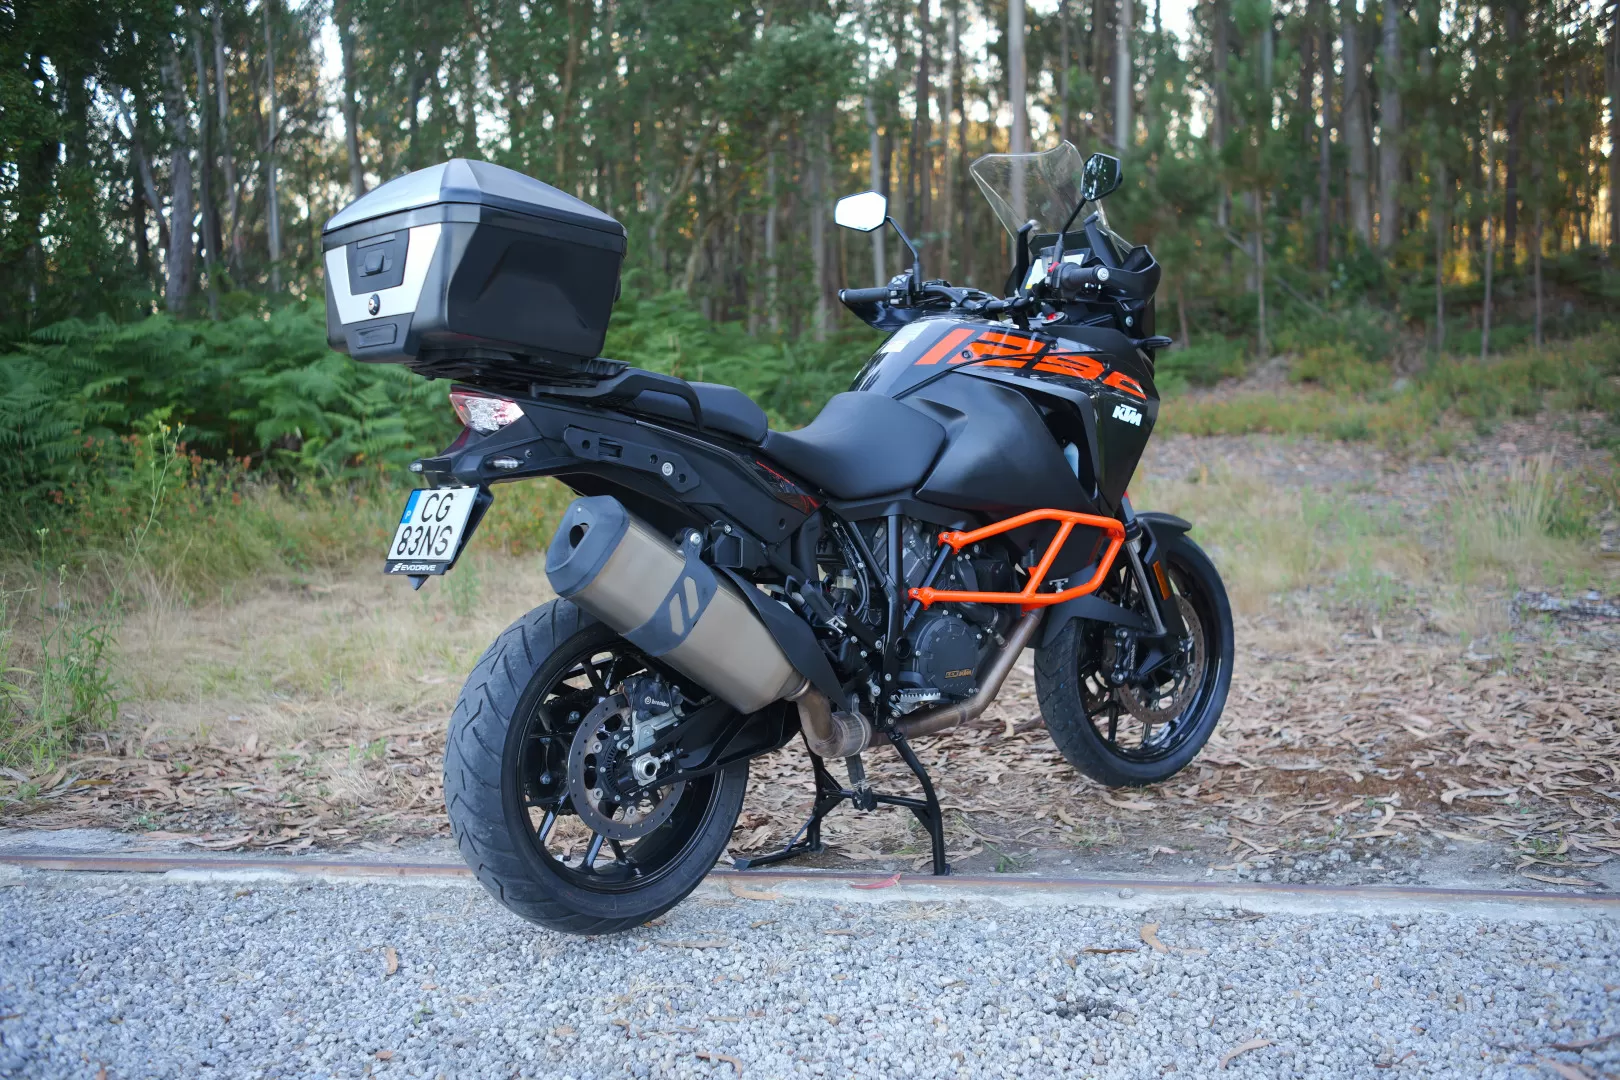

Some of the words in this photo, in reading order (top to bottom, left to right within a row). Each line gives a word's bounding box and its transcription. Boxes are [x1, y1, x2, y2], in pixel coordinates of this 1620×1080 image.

[1112, 403, 1142, 427] KTM
[421, 492, 454, 523] CG
[396, 525, 453, 556] 83NS
[651, 698, 670, 708] brembo
